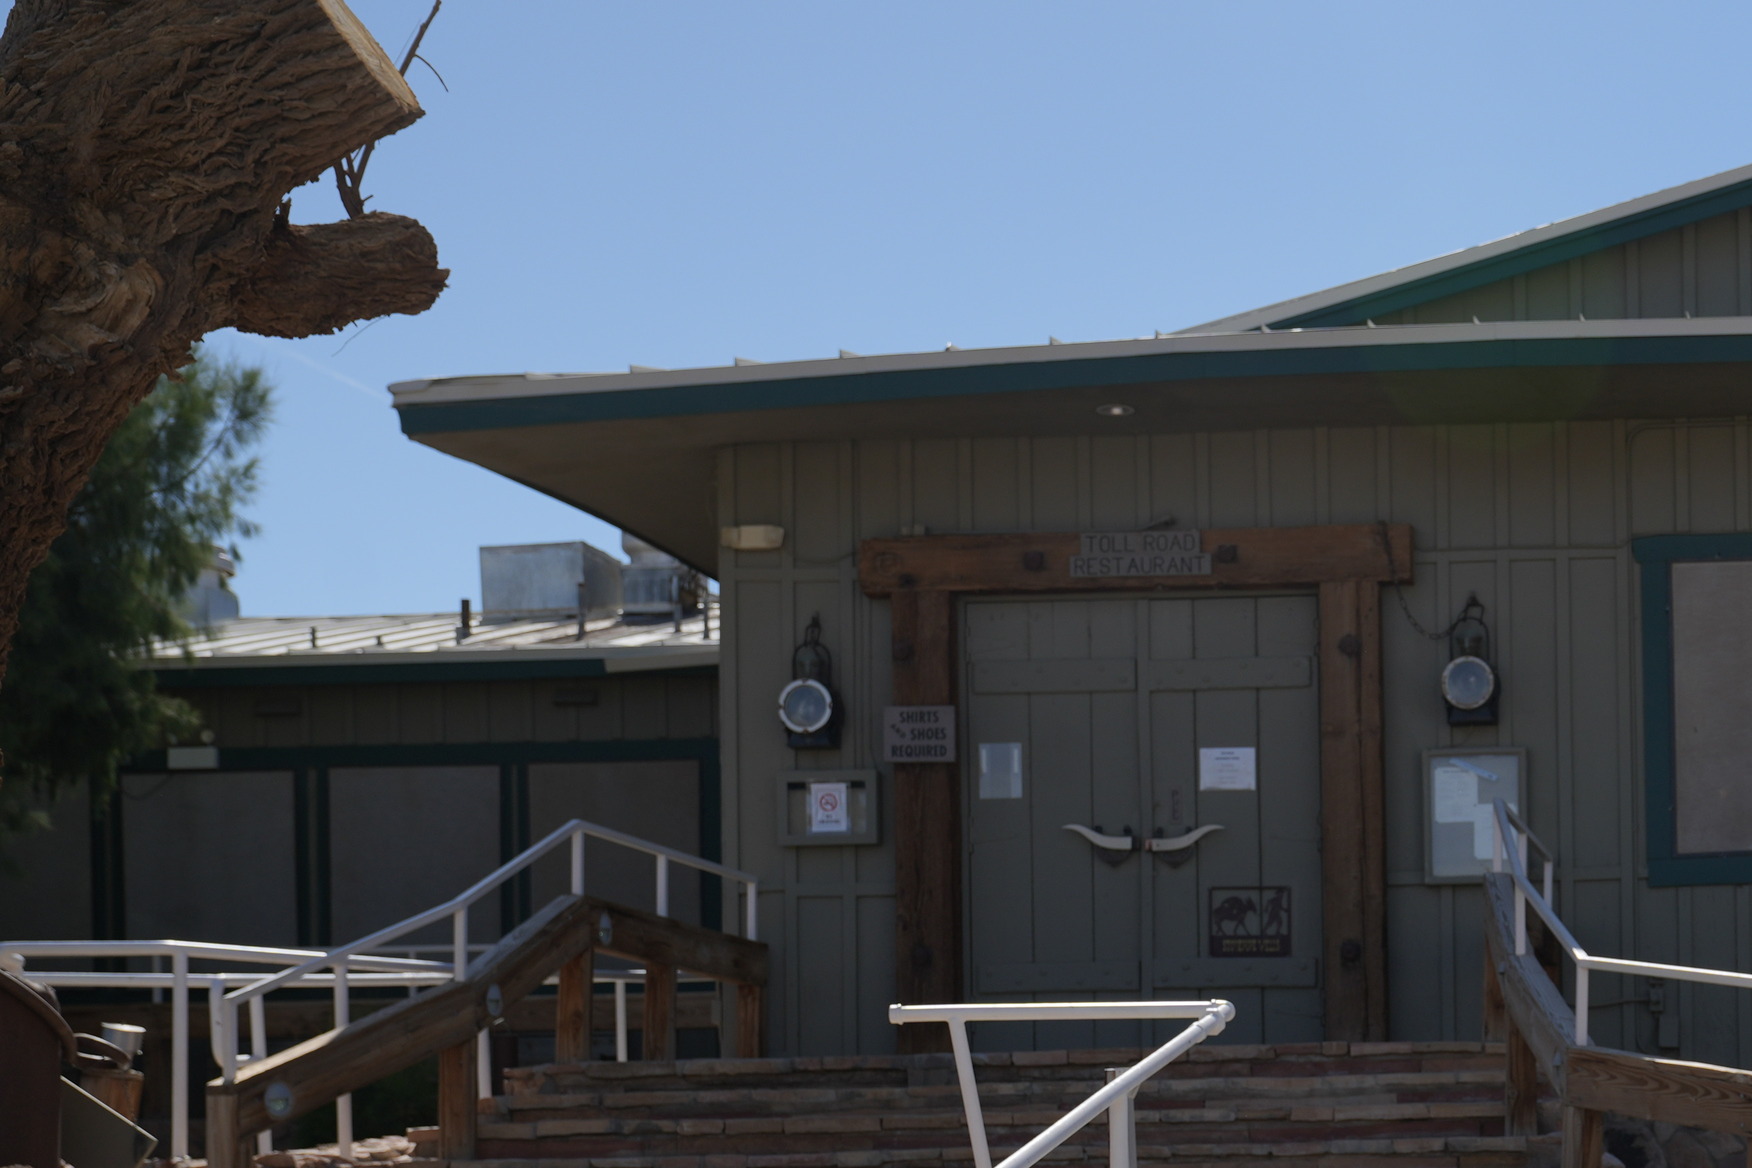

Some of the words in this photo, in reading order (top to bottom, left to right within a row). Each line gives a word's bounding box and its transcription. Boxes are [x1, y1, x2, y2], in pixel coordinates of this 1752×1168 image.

[1085, 534, 1135, 553] TOLL
[1143, 533, 1196, 552] ROAD
[1073, 555, 1206, 576] RESTAURANT
[899, 711, 940, 724] SHIRTS
[910, 727, 947, 741] SHOES
[891, 744, 948, 758] REQUIRED
